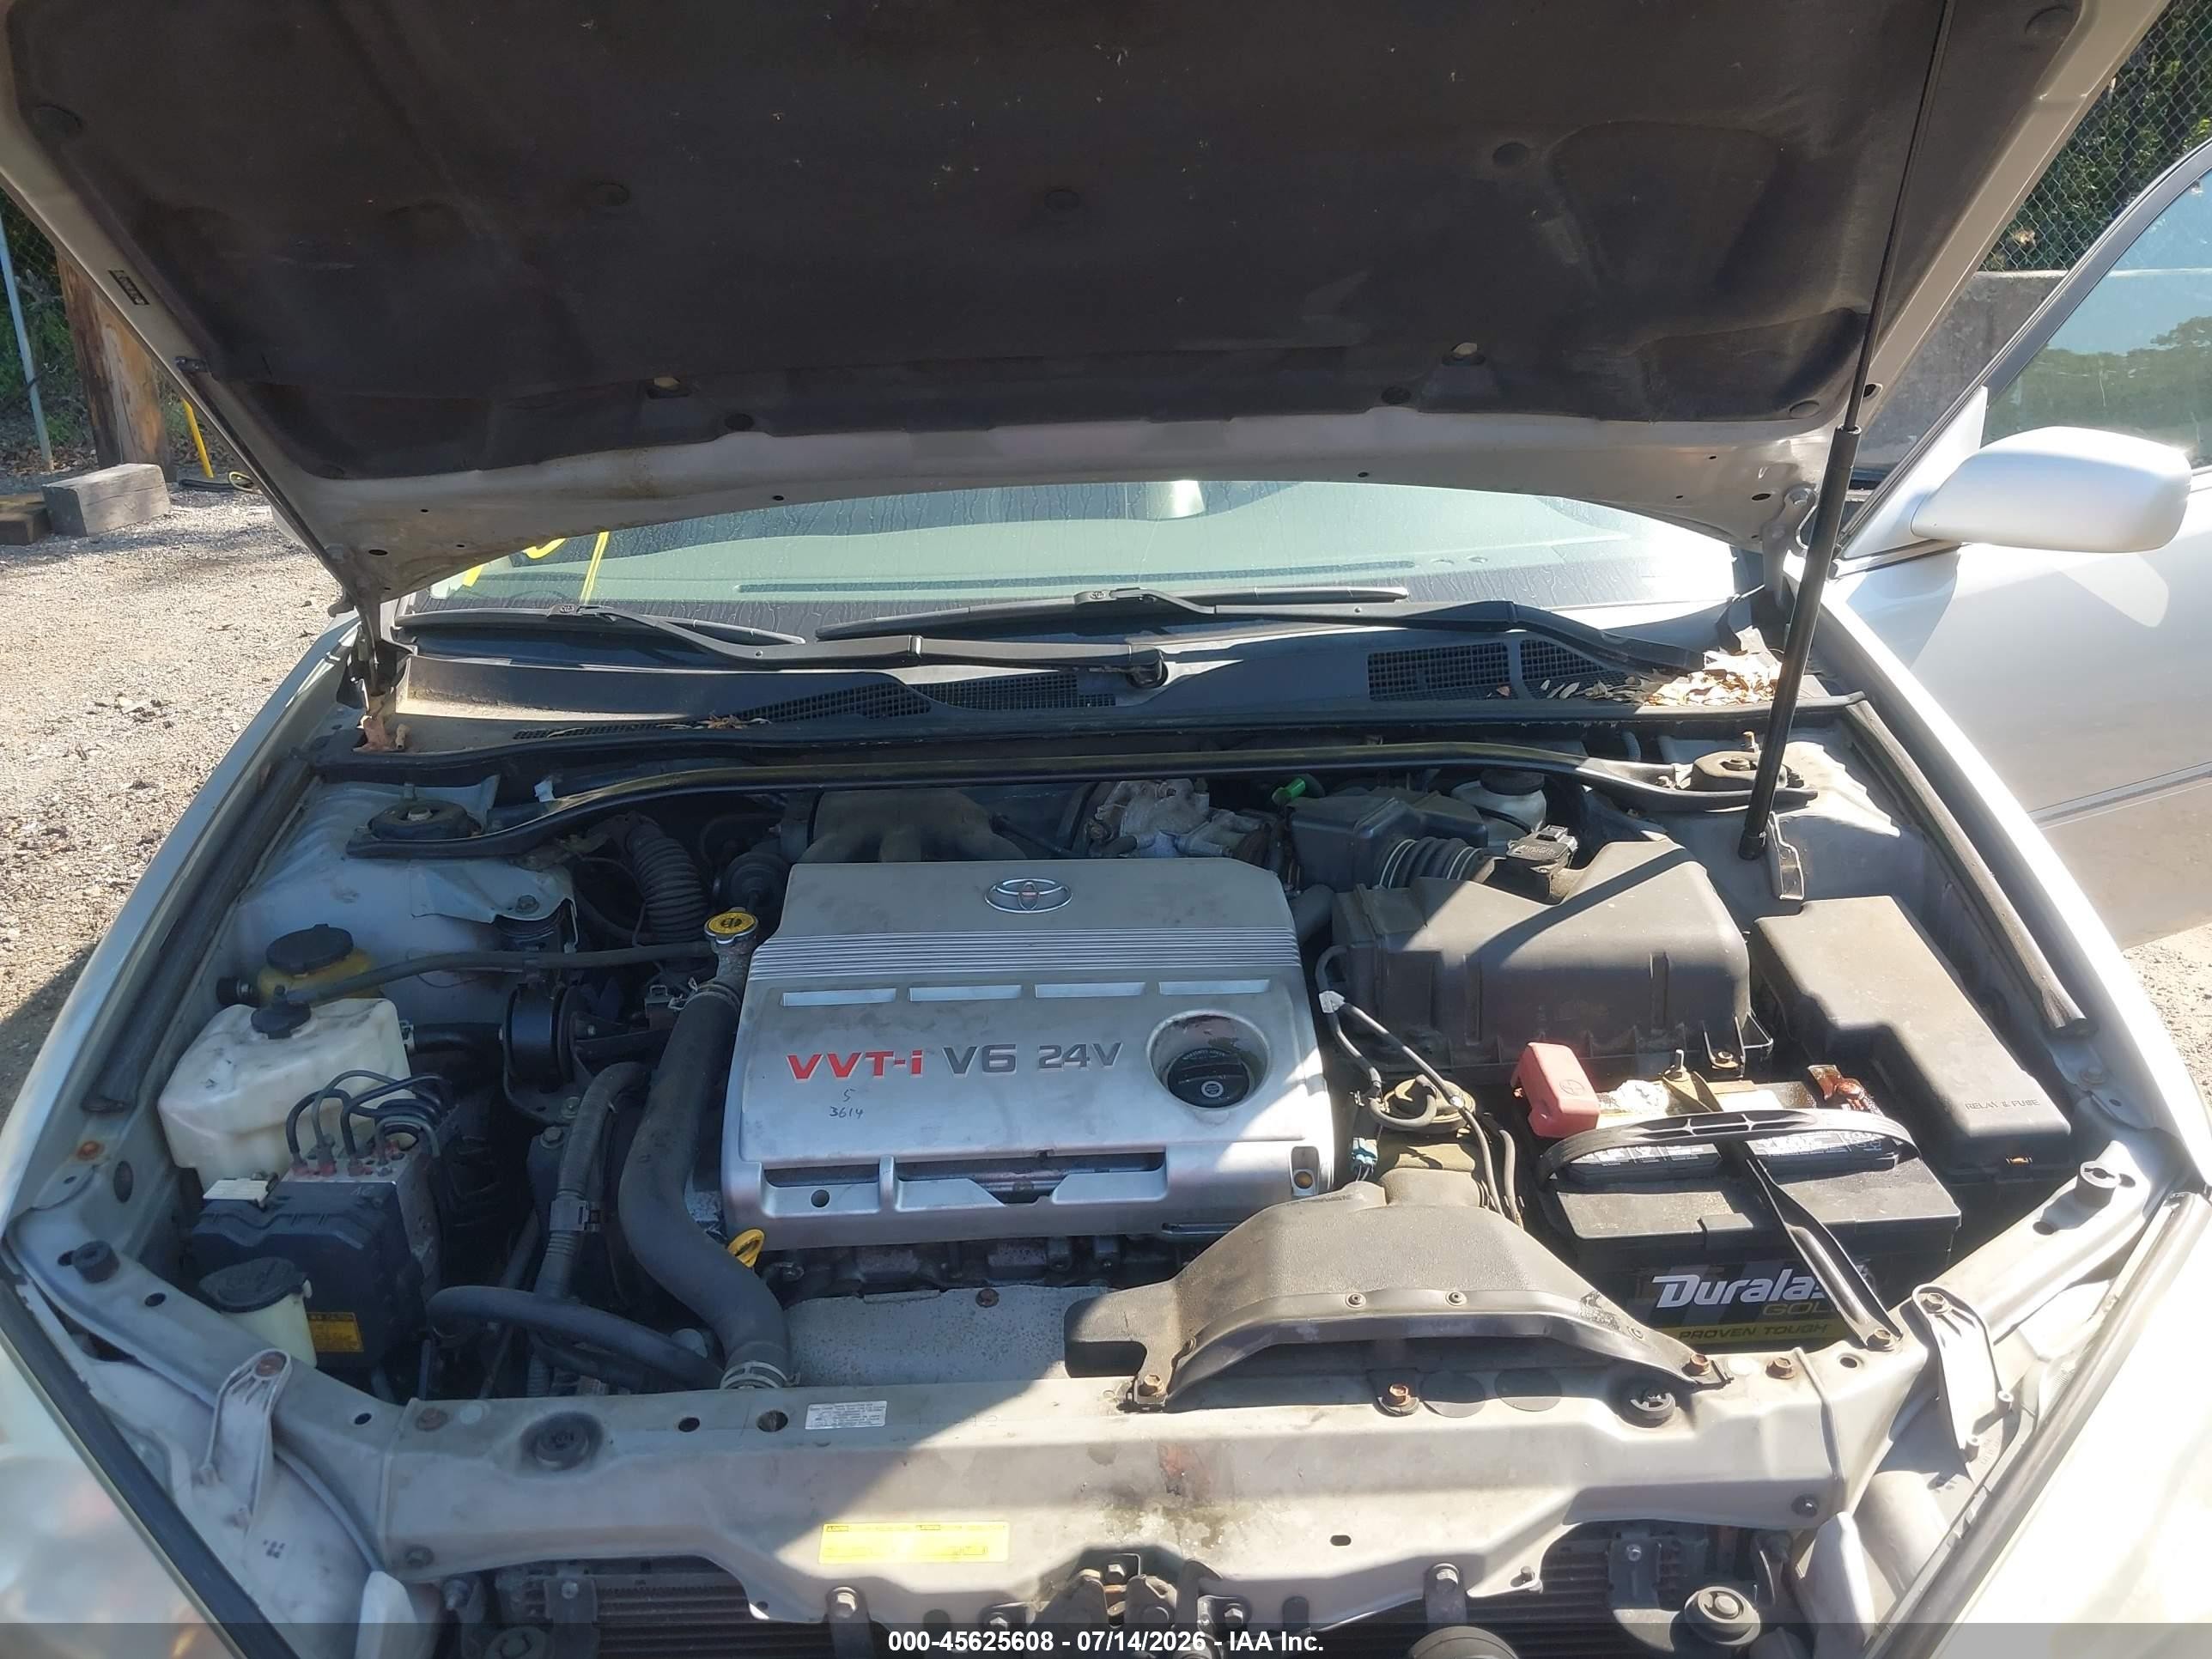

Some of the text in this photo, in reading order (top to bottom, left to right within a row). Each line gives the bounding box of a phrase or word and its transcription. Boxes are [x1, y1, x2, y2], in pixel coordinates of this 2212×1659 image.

[786, 1042, 1123, 1081] VVT-i V6 24V
[829, 1105, 865, 1120] 3614
[1762, 1301, 1831, 1316] GOL
[1679, 1322, 1829, 1340] PROVEN TOUGH
